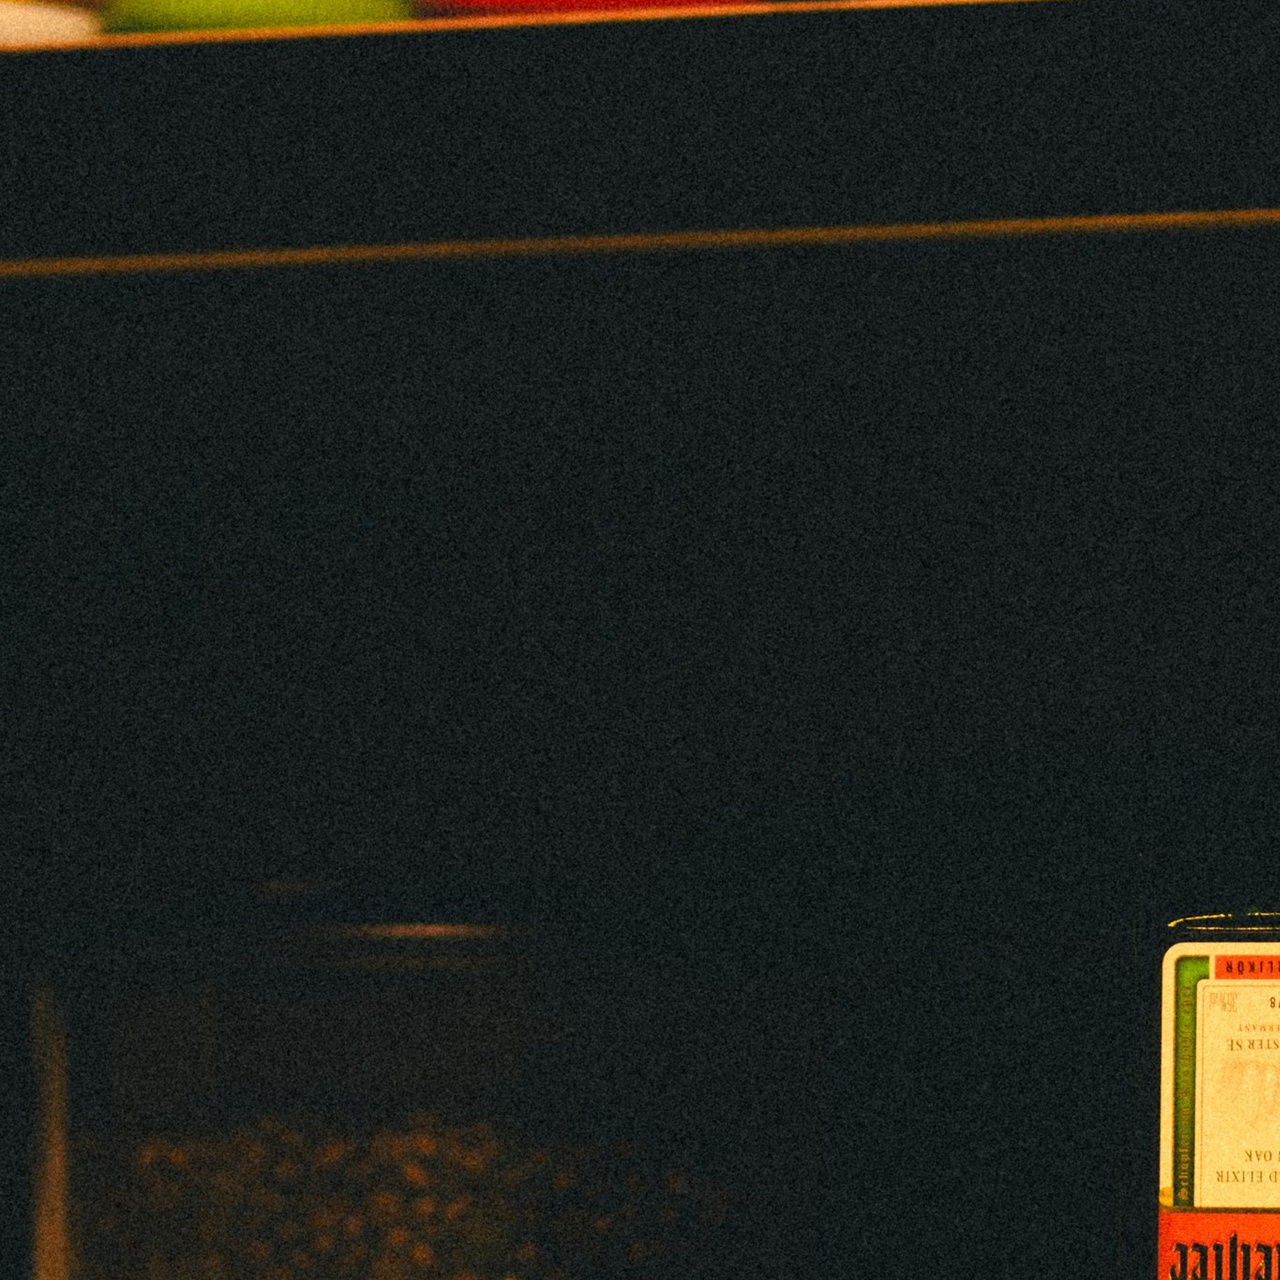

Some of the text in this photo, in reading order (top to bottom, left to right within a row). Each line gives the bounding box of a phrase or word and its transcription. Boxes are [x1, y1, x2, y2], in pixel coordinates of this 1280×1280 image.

[1226, 1038, 1244, 1051] SE
[1244, 1149, 1273, 1162] OAK
[1216, 1170, 1263, 1183] ELIXIR
